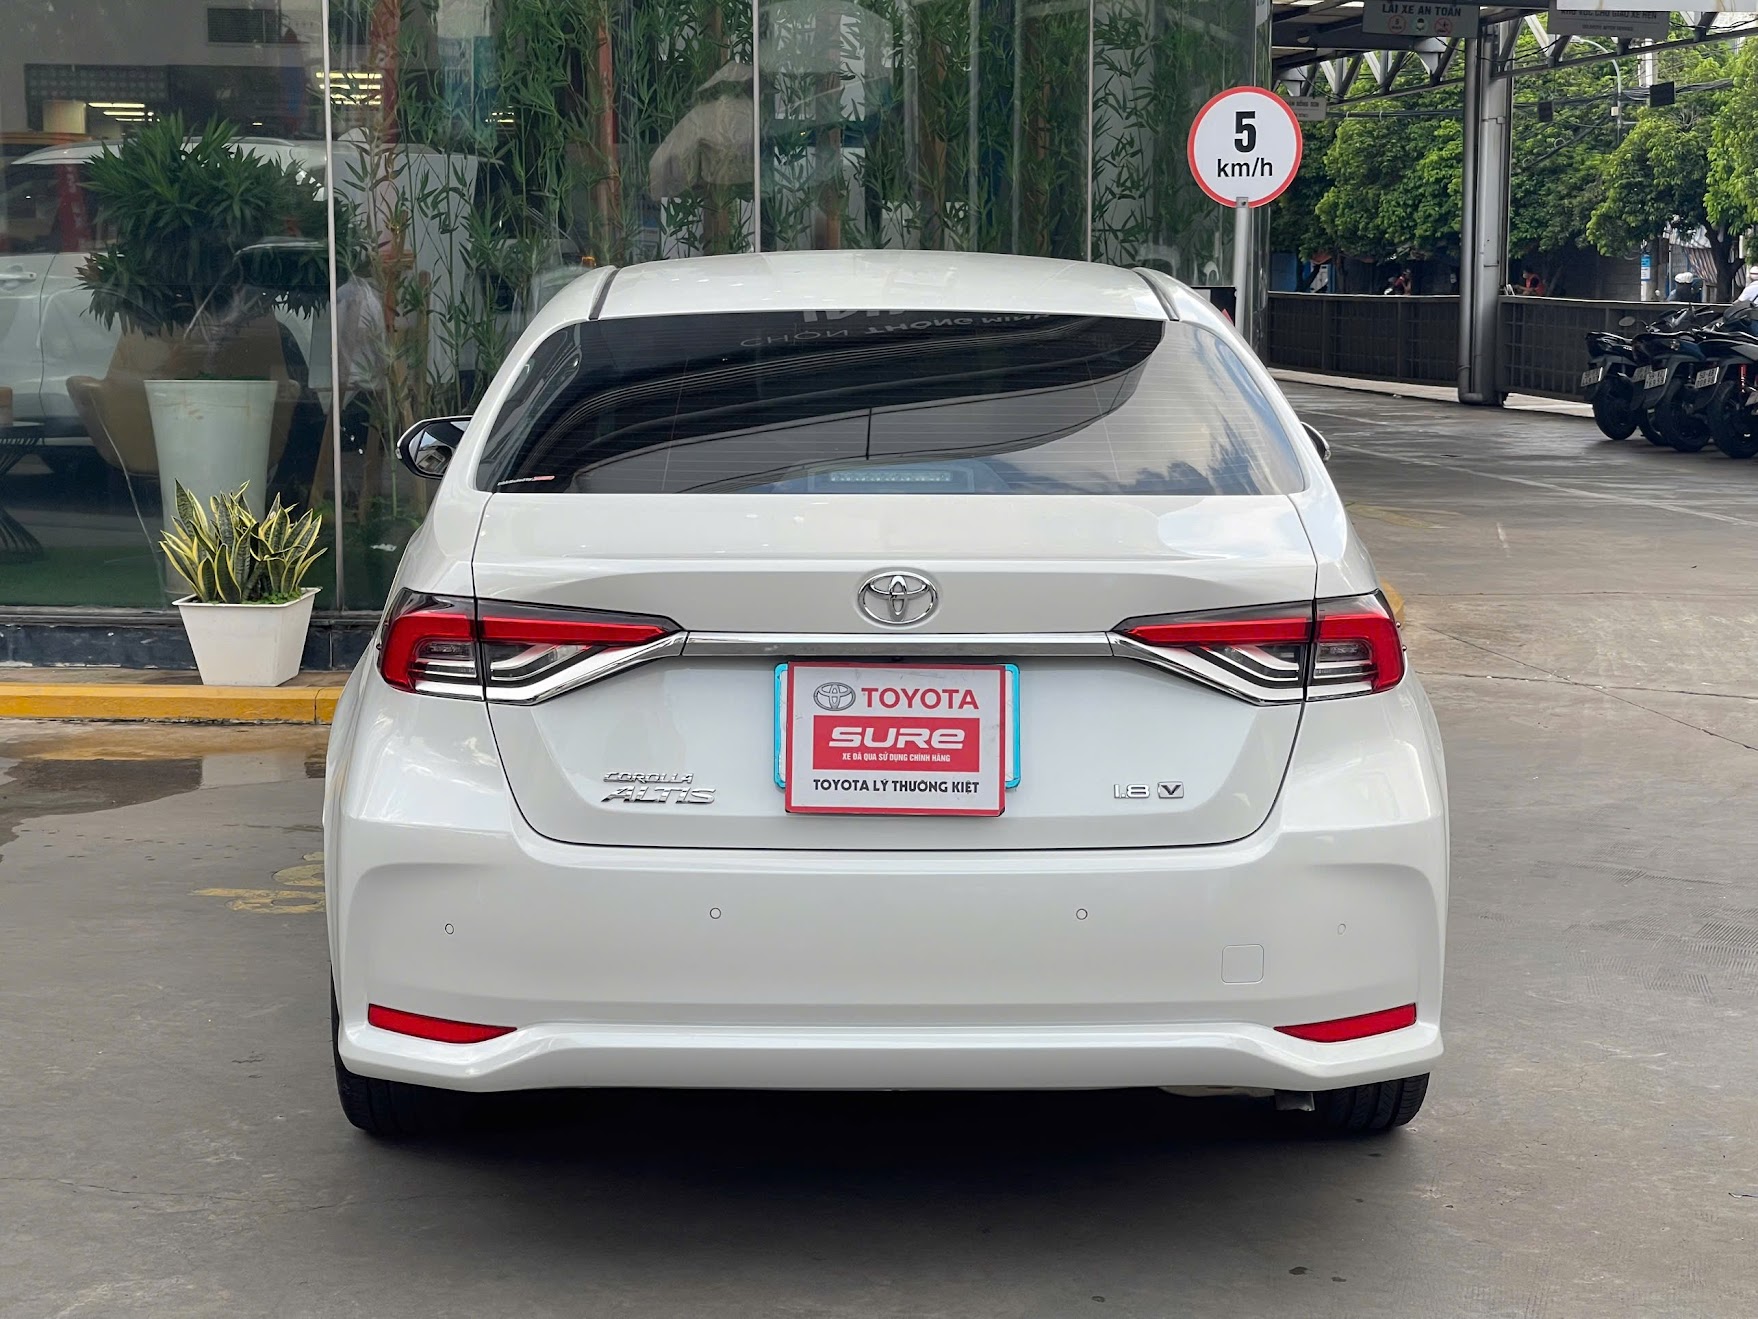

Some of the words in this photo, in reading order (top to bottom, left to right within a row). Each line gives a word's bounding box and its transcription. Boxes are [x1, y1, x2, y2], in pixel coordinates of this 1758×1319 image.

[1401, 4, 1415, 15] XE
[1418, 5, 1432, 16] AN
[1234, 111, 1257, 153] 5
[1217, 157, 1273, 177] km/h
[861, 687, 979, 710] TOYOTA
[842, 752, 851, 762] XE
[863, 752, 877, 762] QUA
[603, 771, 694, 784] COROLLA
[813, 778, 870, 792] TOYOTA
[873, 777, 889, 792] LÝ
[951, 779, 980, 795] KIỆT
[600, 785, 717, 804] ALTIS
[1159, 783, 1182, 797] V
